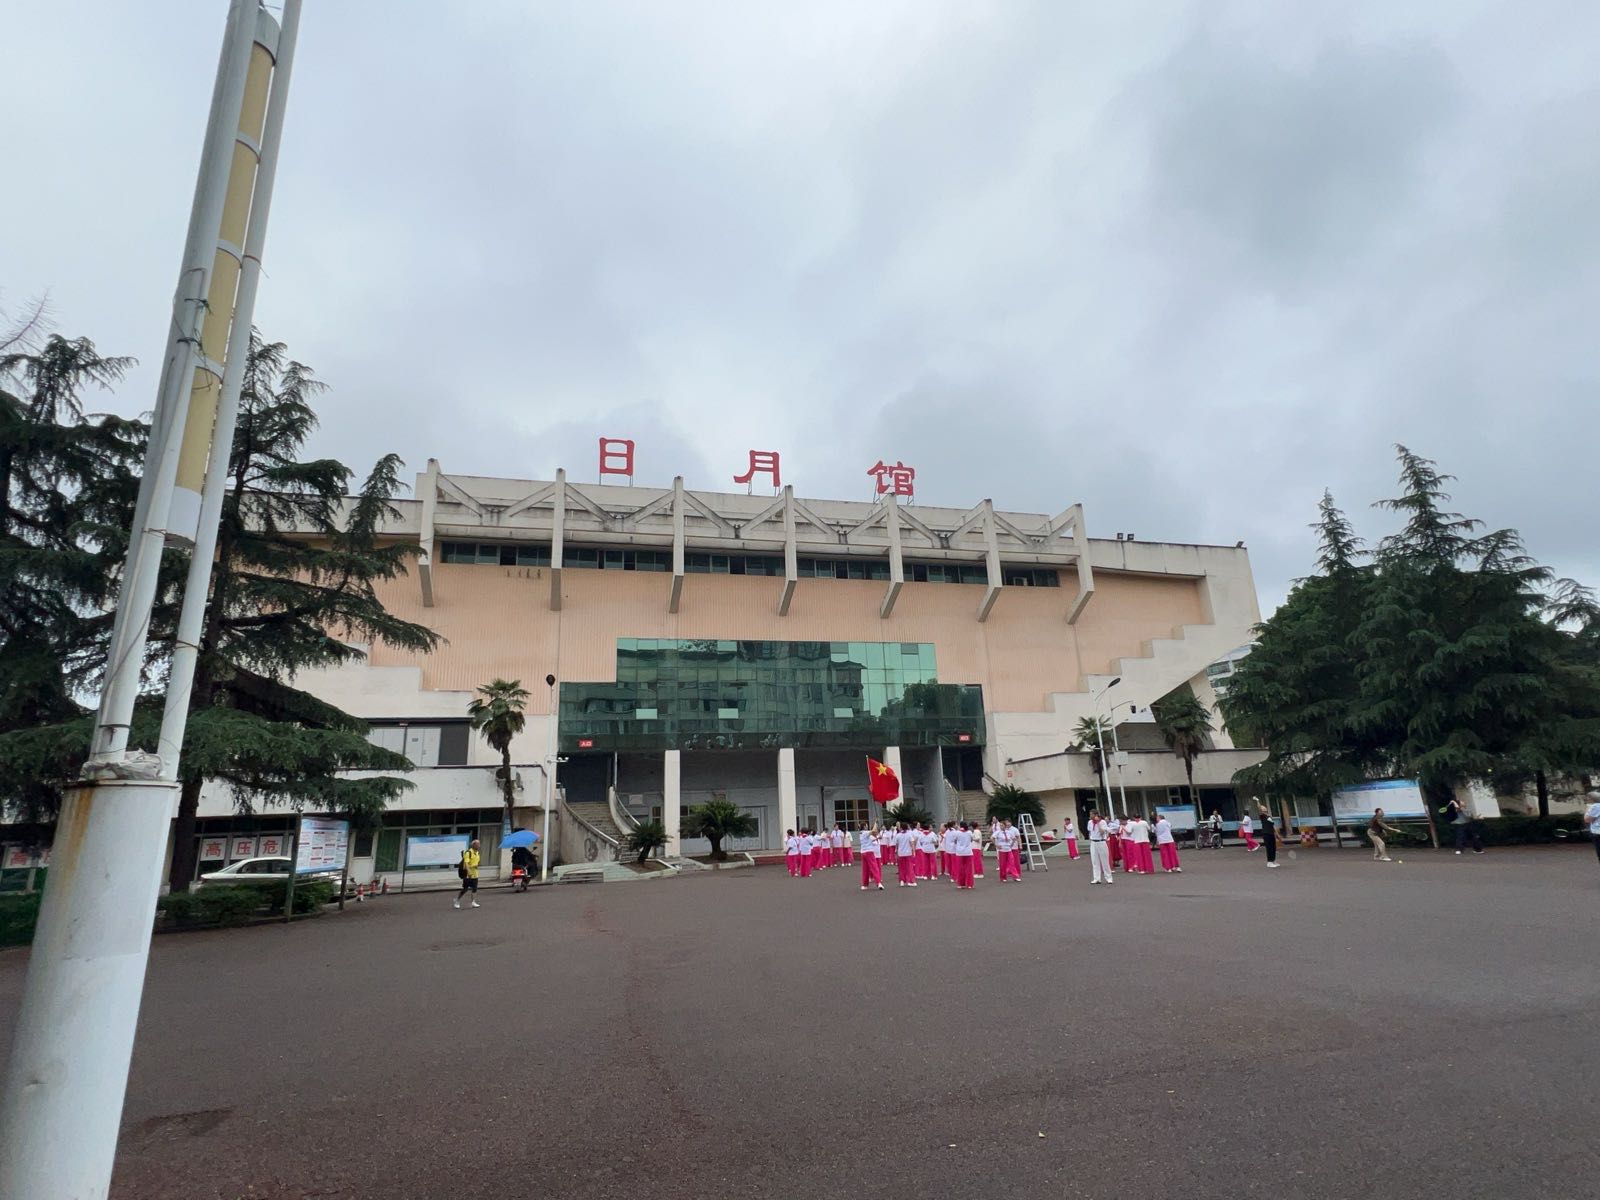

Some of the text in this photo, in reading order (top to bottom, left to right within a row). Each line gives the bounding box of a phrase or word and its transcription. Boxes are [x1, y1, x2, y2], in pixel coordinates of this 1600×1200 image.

[599, 437, 915, 496] 日月馆
[205, 839, 278, 857] 高压危
